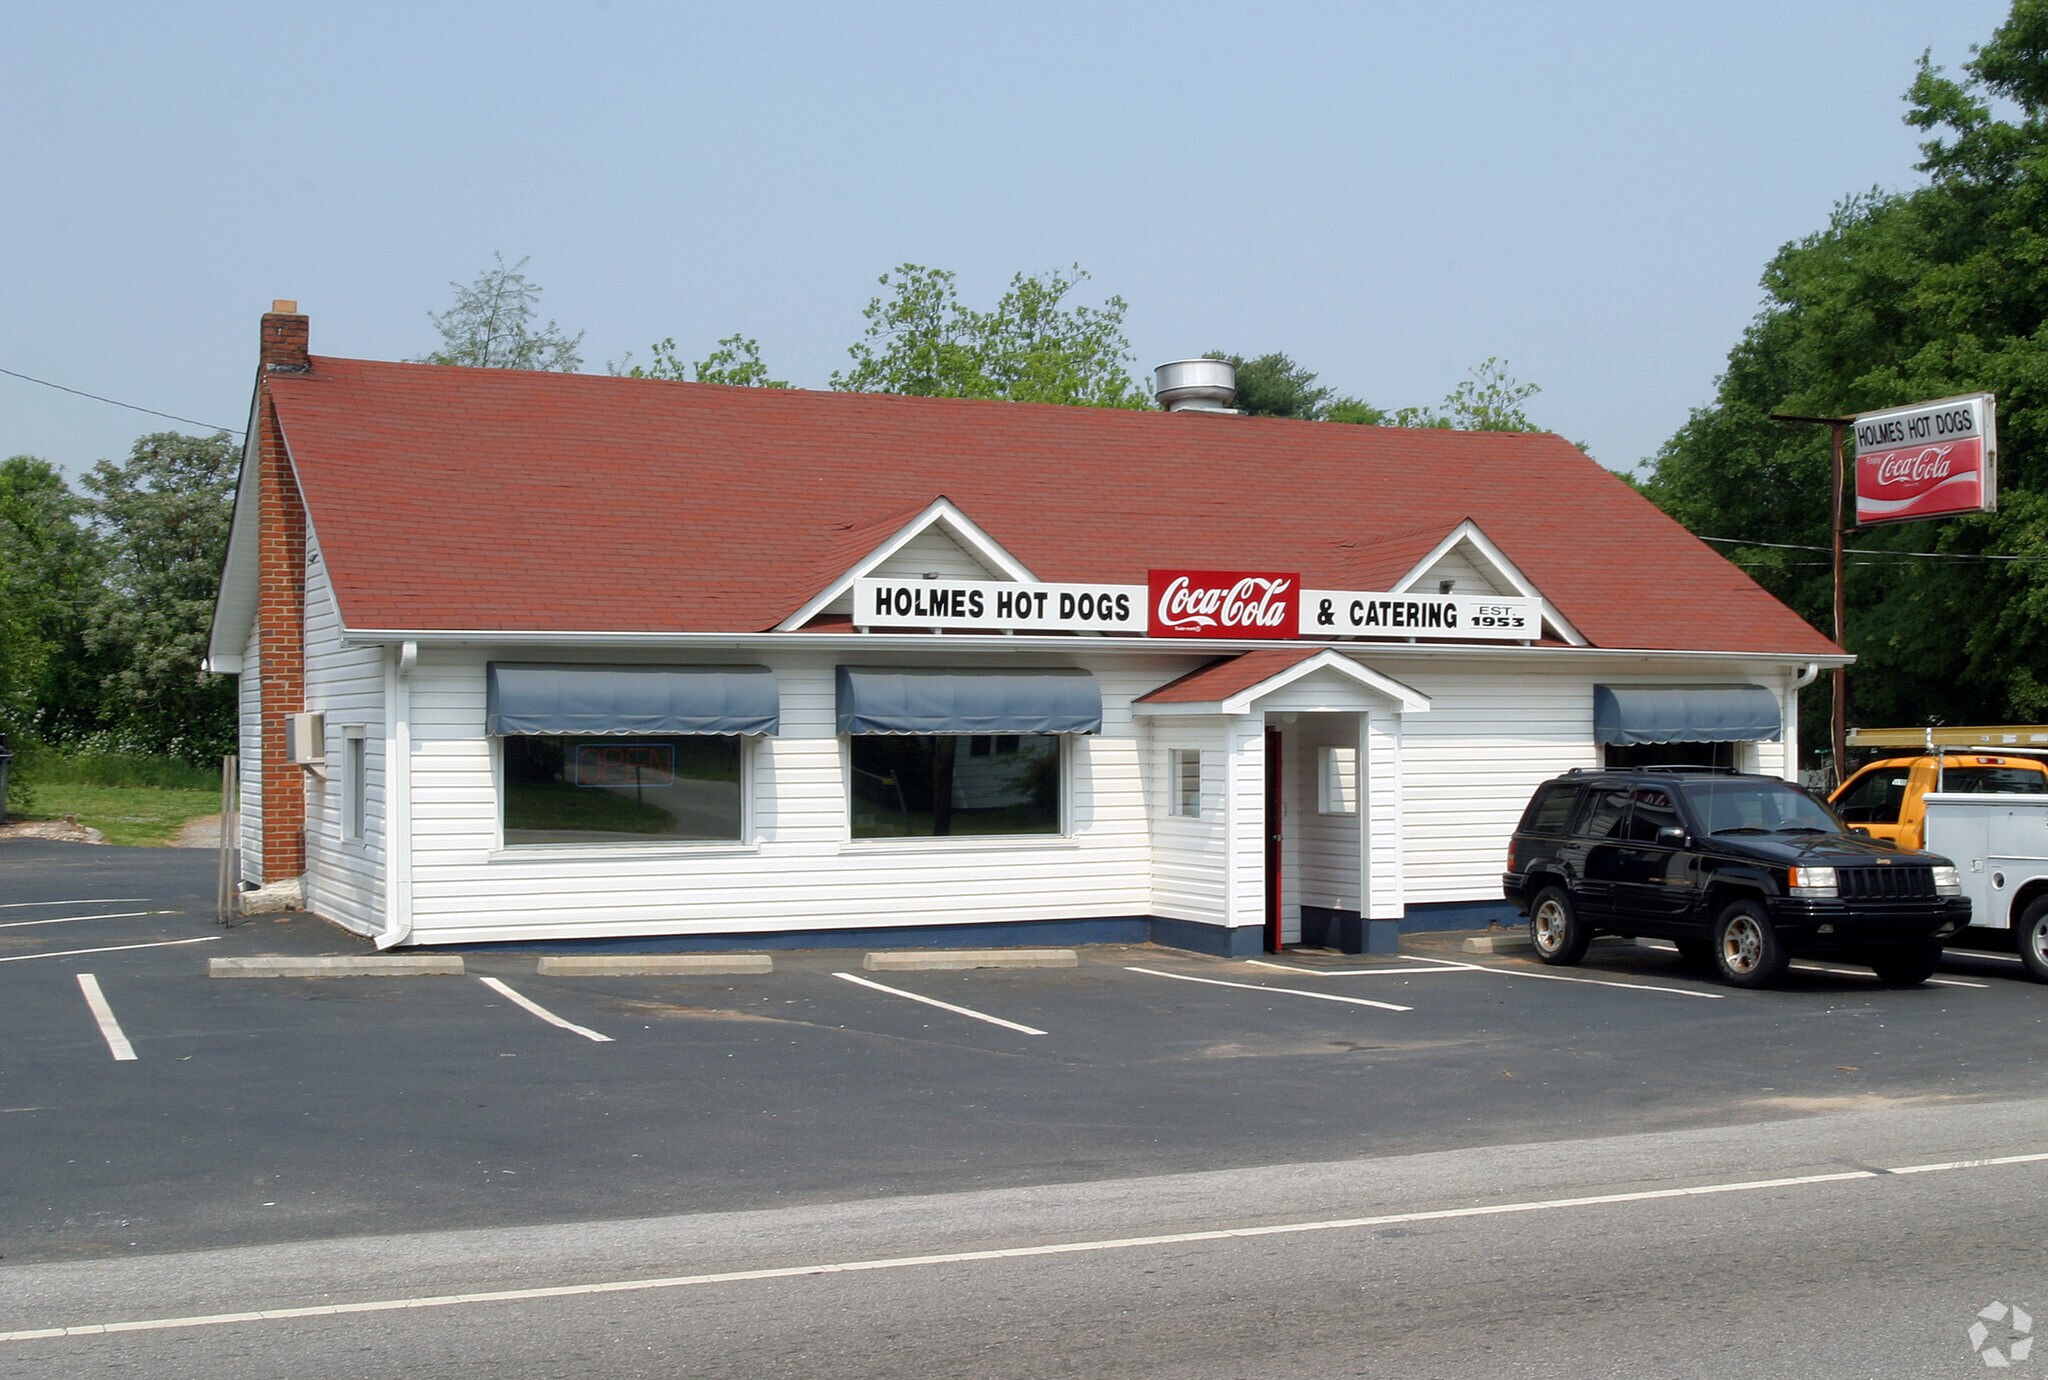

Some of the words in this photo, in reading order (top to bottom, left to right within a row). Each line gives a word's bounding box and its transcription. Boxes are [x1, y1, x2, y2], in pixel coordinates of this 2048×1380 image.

[1857, 421, 1905, 448] HOLMES
[1907, 416, 1932, 440] HOT
[1935, 409, 1973, 435] DOGS
[1877, 444, 1953, 486] Coca-Cola
[875, 586, 985, 618] HOLMES
[997, 590, 1048, 620] HOT
[1059, 592, 1130, 622] DOGS
[1157, 576, 1292, 627] Coca-Cola
[1316, 598, 1336, 626] &
[1348, 600, 1458, 629] CATERING
[1478, 605, 1517, 616] EST.
[1471, 616, 1525, 627] 1953
[580, 748, 672, 785] OPEN
